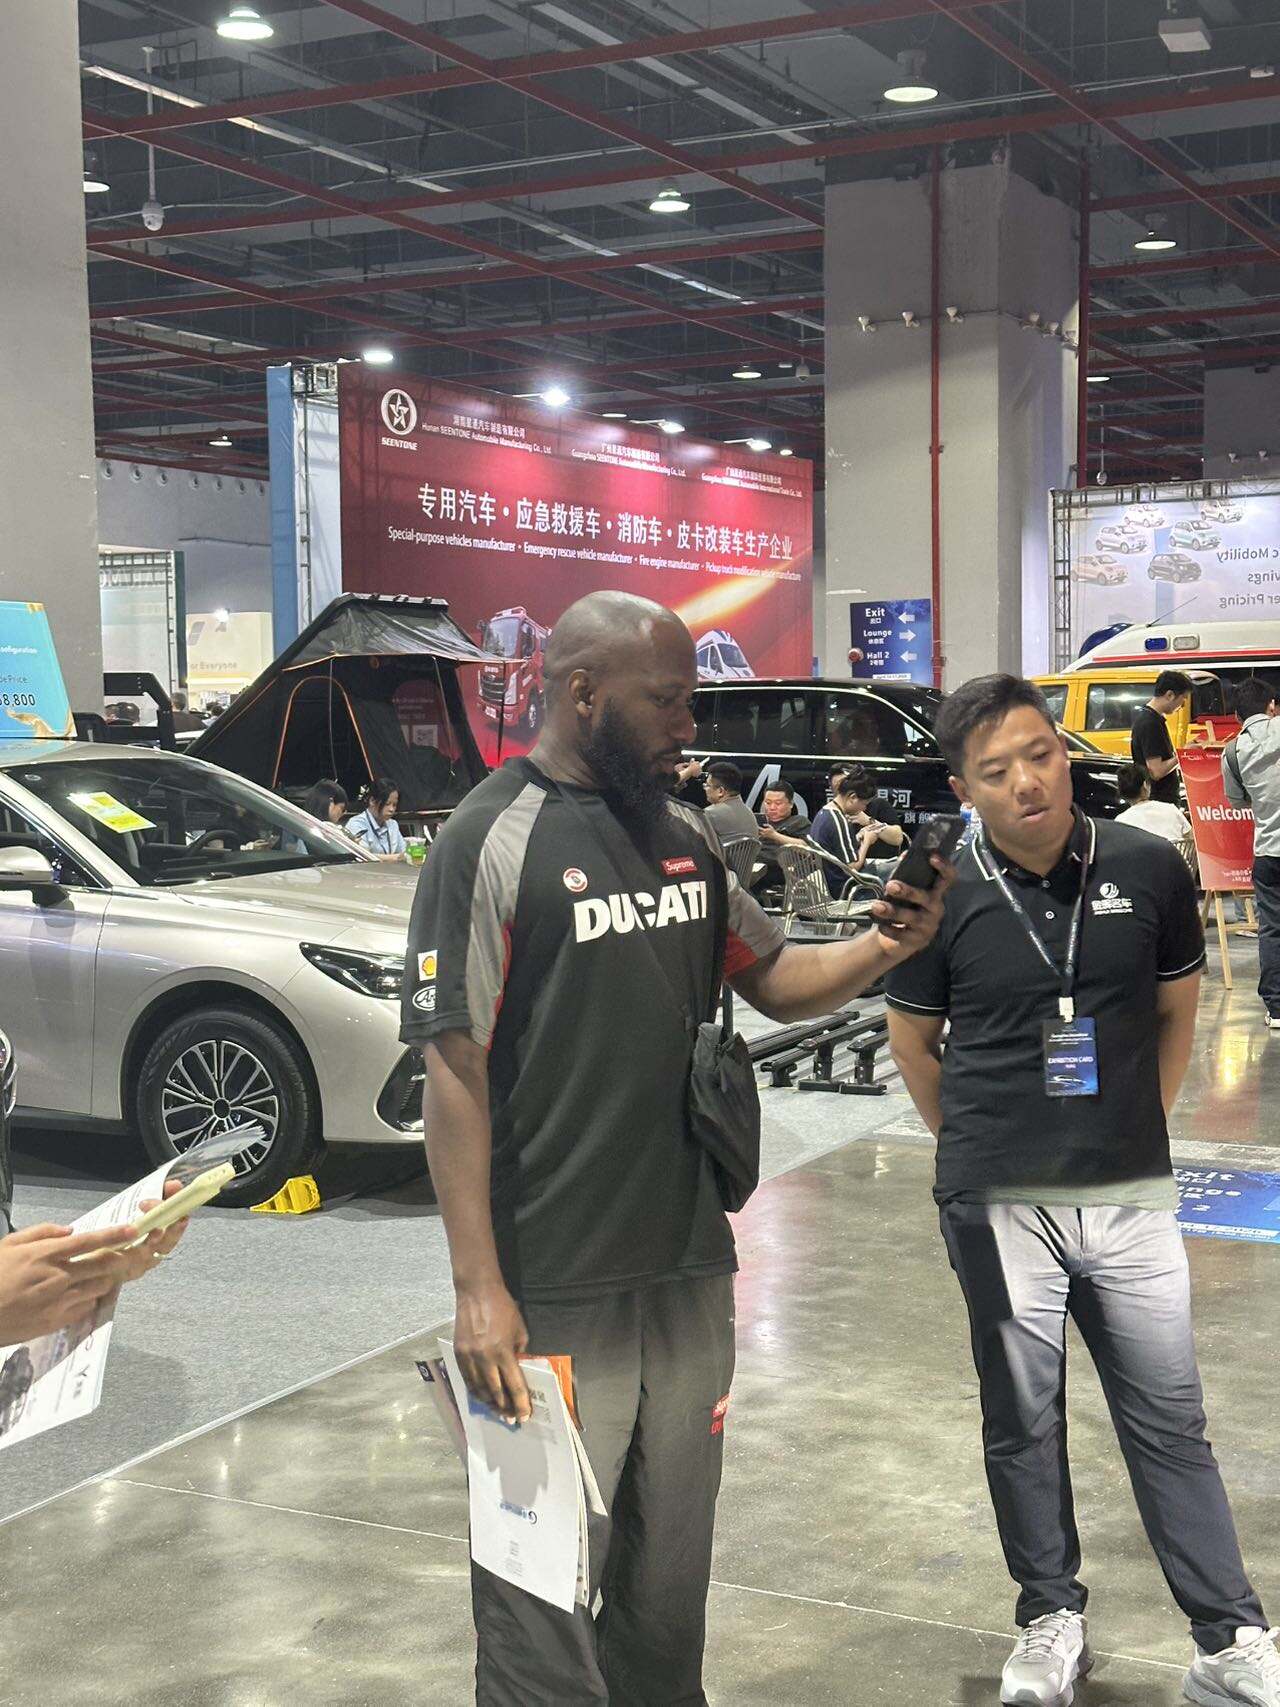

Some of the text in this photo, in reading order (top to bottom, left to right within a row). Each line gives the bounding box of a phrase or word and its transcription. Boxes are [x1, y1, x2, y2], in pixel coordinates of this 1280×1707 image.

[440, 425, 471, 439] SEENTONE
[381, 436, 418, 450] SEENTONE
[388, 526, 445, 546] Special-purpose
[445, 533, 472, 548] vehicles
[472, 537, 516, 553] manufacturer
[523, 541, 558, 560] Emergency
[557, 548, 577, 560] rescue
[576, 548, 597, 561] vehicle
[596, 550, 633, 565] manufacturer
[650, 556, 668, 570] engine
[865, 607, 886, 617] Exit
[863, 630, 892, 638] Lounge
[866, 651, 890, 660] Hall 2
[200, 661, 238, 673] Everyone
[666, 859, 695, 873] Supreme
[573, 880, 707, 943] DUCATI
